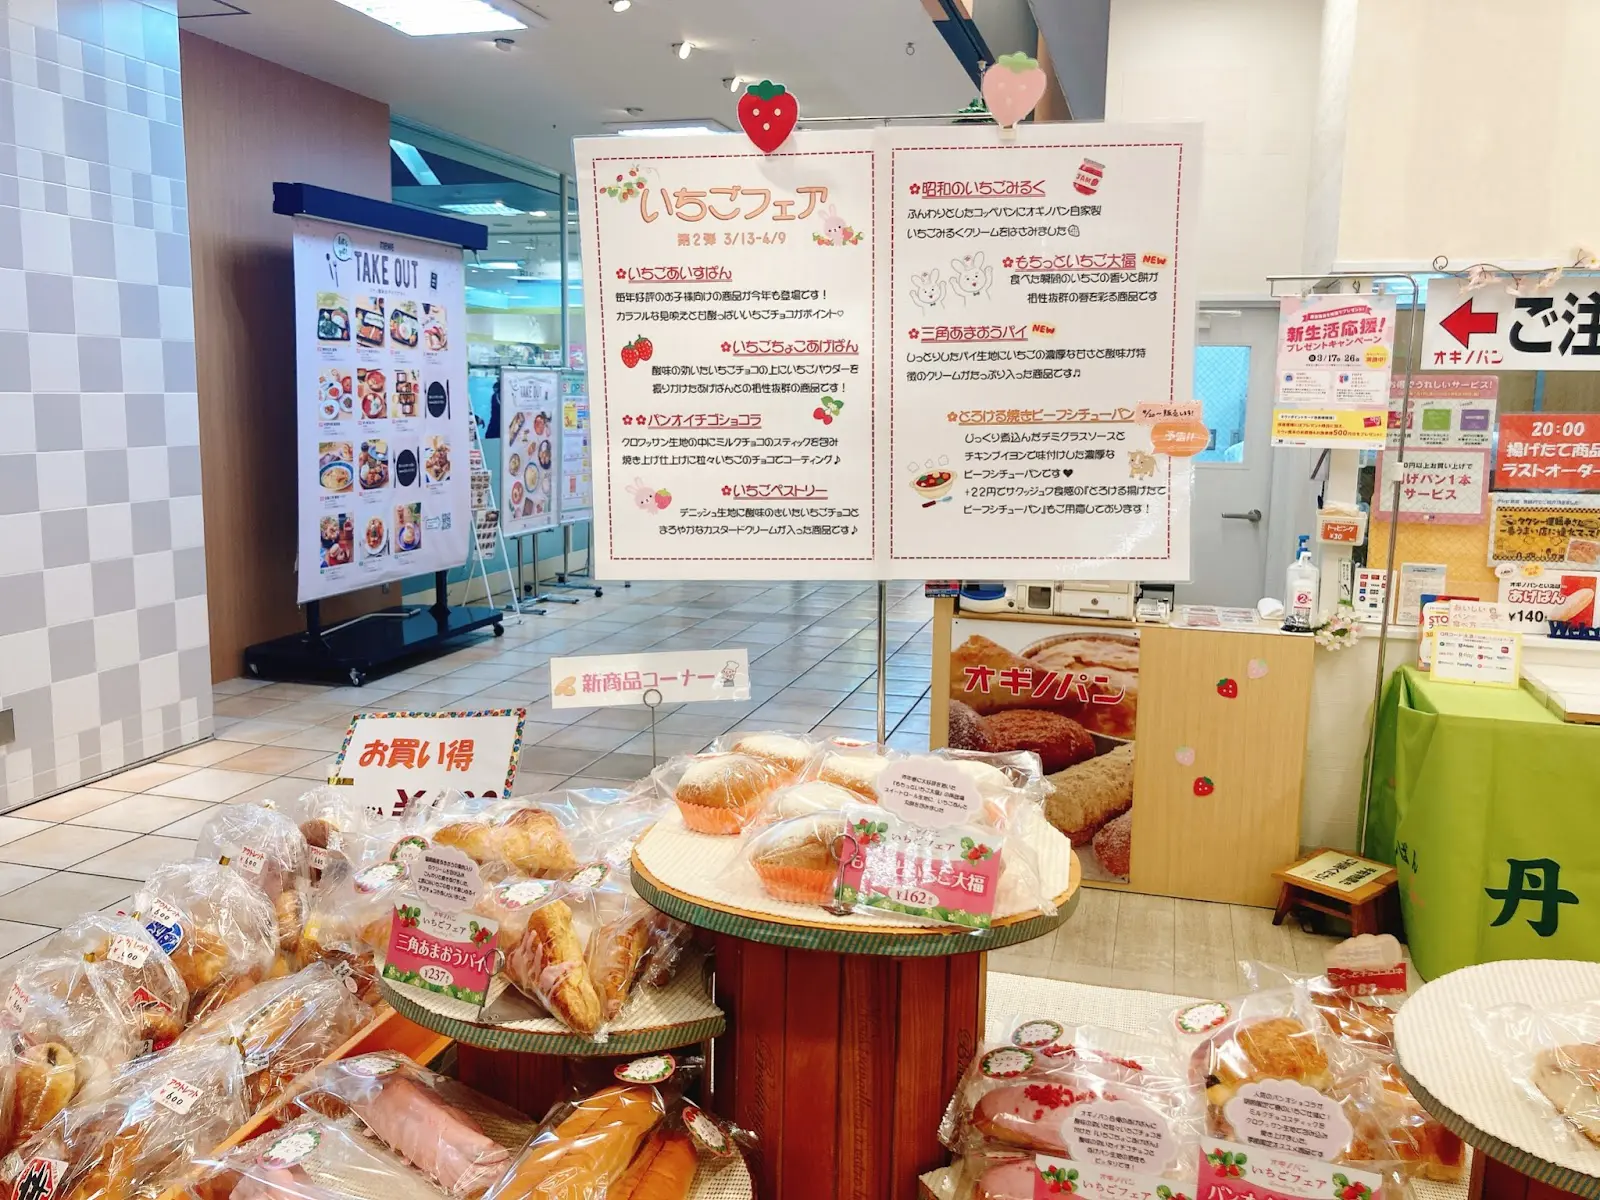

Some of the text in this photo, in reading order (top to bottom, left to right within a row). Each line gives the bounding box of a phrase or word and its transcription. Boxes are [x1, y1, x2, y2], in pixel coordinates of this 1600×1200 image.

[921, 180, 1046, 197] 昭和のいちごみるく
[640, 185, 828, 223] いちごフェア
[907, 205, 1102, 220] ふんわりとしたコッペパンにオギノパン自家製
[677, 231, 786, 246] 第2弾 3/13-4/9
[906, 226, 1067, 239] いちごみるくクリームをはさみました
[1015, 253, 1167, 270] もちっといちご大福 NEW
[354, 251, 389, 285] TAKE
[394, 258, 418, 289] OUT
[628, 265, 732, 281] いちごあいすぱん
[1027, 291, 1158, 304] 相性抜群の春を彩る商品です
[921, 323, 1056, 341] 三角あまおうパイ NEW
[733, 340, 859, 354] いちごちょこあげぱん
[648, 413, 762, 428] パンオイチゴショコラ
[958, 409, 1135, 423] とろける焼きビーフシチューパン
[1531, 421, 1586, 437] 20:00
[965, 431, 1126, 444] じっくり煮込んだデミグラスソースと
[965, 449, 1115, 461] チキンブイヨンで味付けした濃厚な
[1401, 474, 1472, 487] げパン1本
[733, 484, 829, 498] いちごペストリー
[1404, 488, 1457, 500] サービス
[1508, 610, 1544, 623] ¥140
[582, 670, 715, 694] 新商品コーナー
[962, 664, 1127, 705] オギノパン
[358, 738, 475, 772] お買い得
[1484, 857, 1580, 938] 丹
[422, 917, 467, 935] いちごフェア
[396, 933, 486, 973] 三角あまおうパイ
[1251, 1165, 1327, 1189] いちごフェア
[1083, 1180, 1152, 1200] いちごフェア
